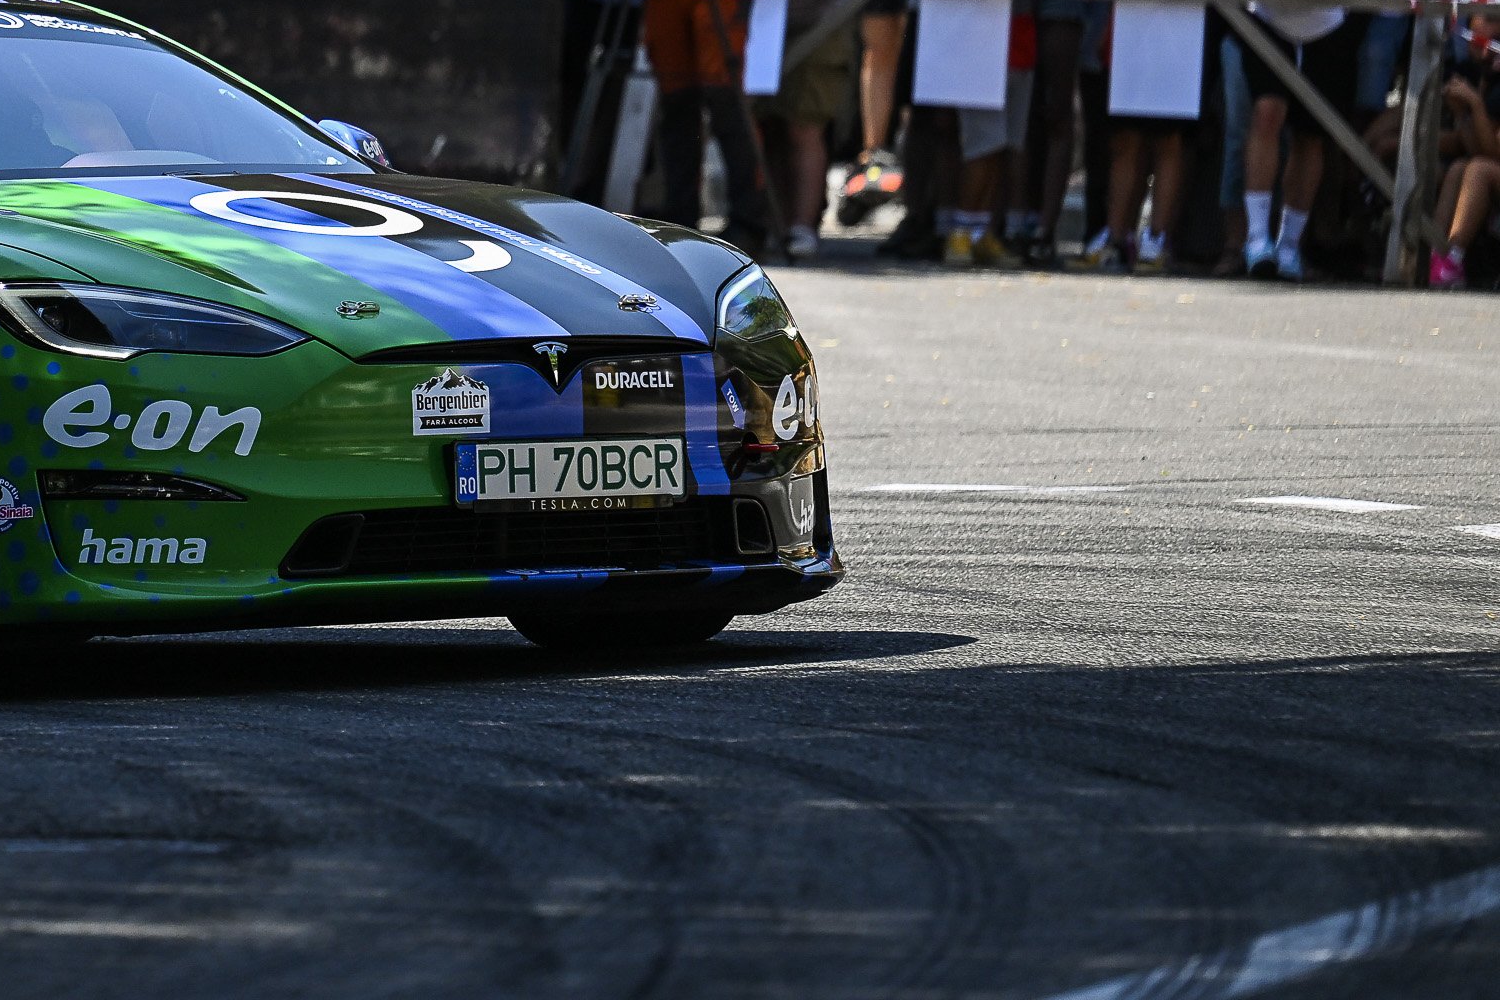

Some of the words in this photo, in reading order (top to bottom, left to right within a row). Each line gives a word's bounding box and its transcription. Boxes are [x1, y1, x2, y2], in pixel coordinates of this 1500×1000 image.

[595, 371, 674, 390] DURACELL
[416, 391, 487, 413] Bergenbier
[726, 387, 741, 414] TOW
[478, 447, 536, 495] PH
[553, 443, 679, 493] 70BCR
[459, 477, 477, 495] RO
[530, 498, 627, 511] TESLA.COM
[800, 499, 815, 535] ha
[78, 528, 207, 564] hama
